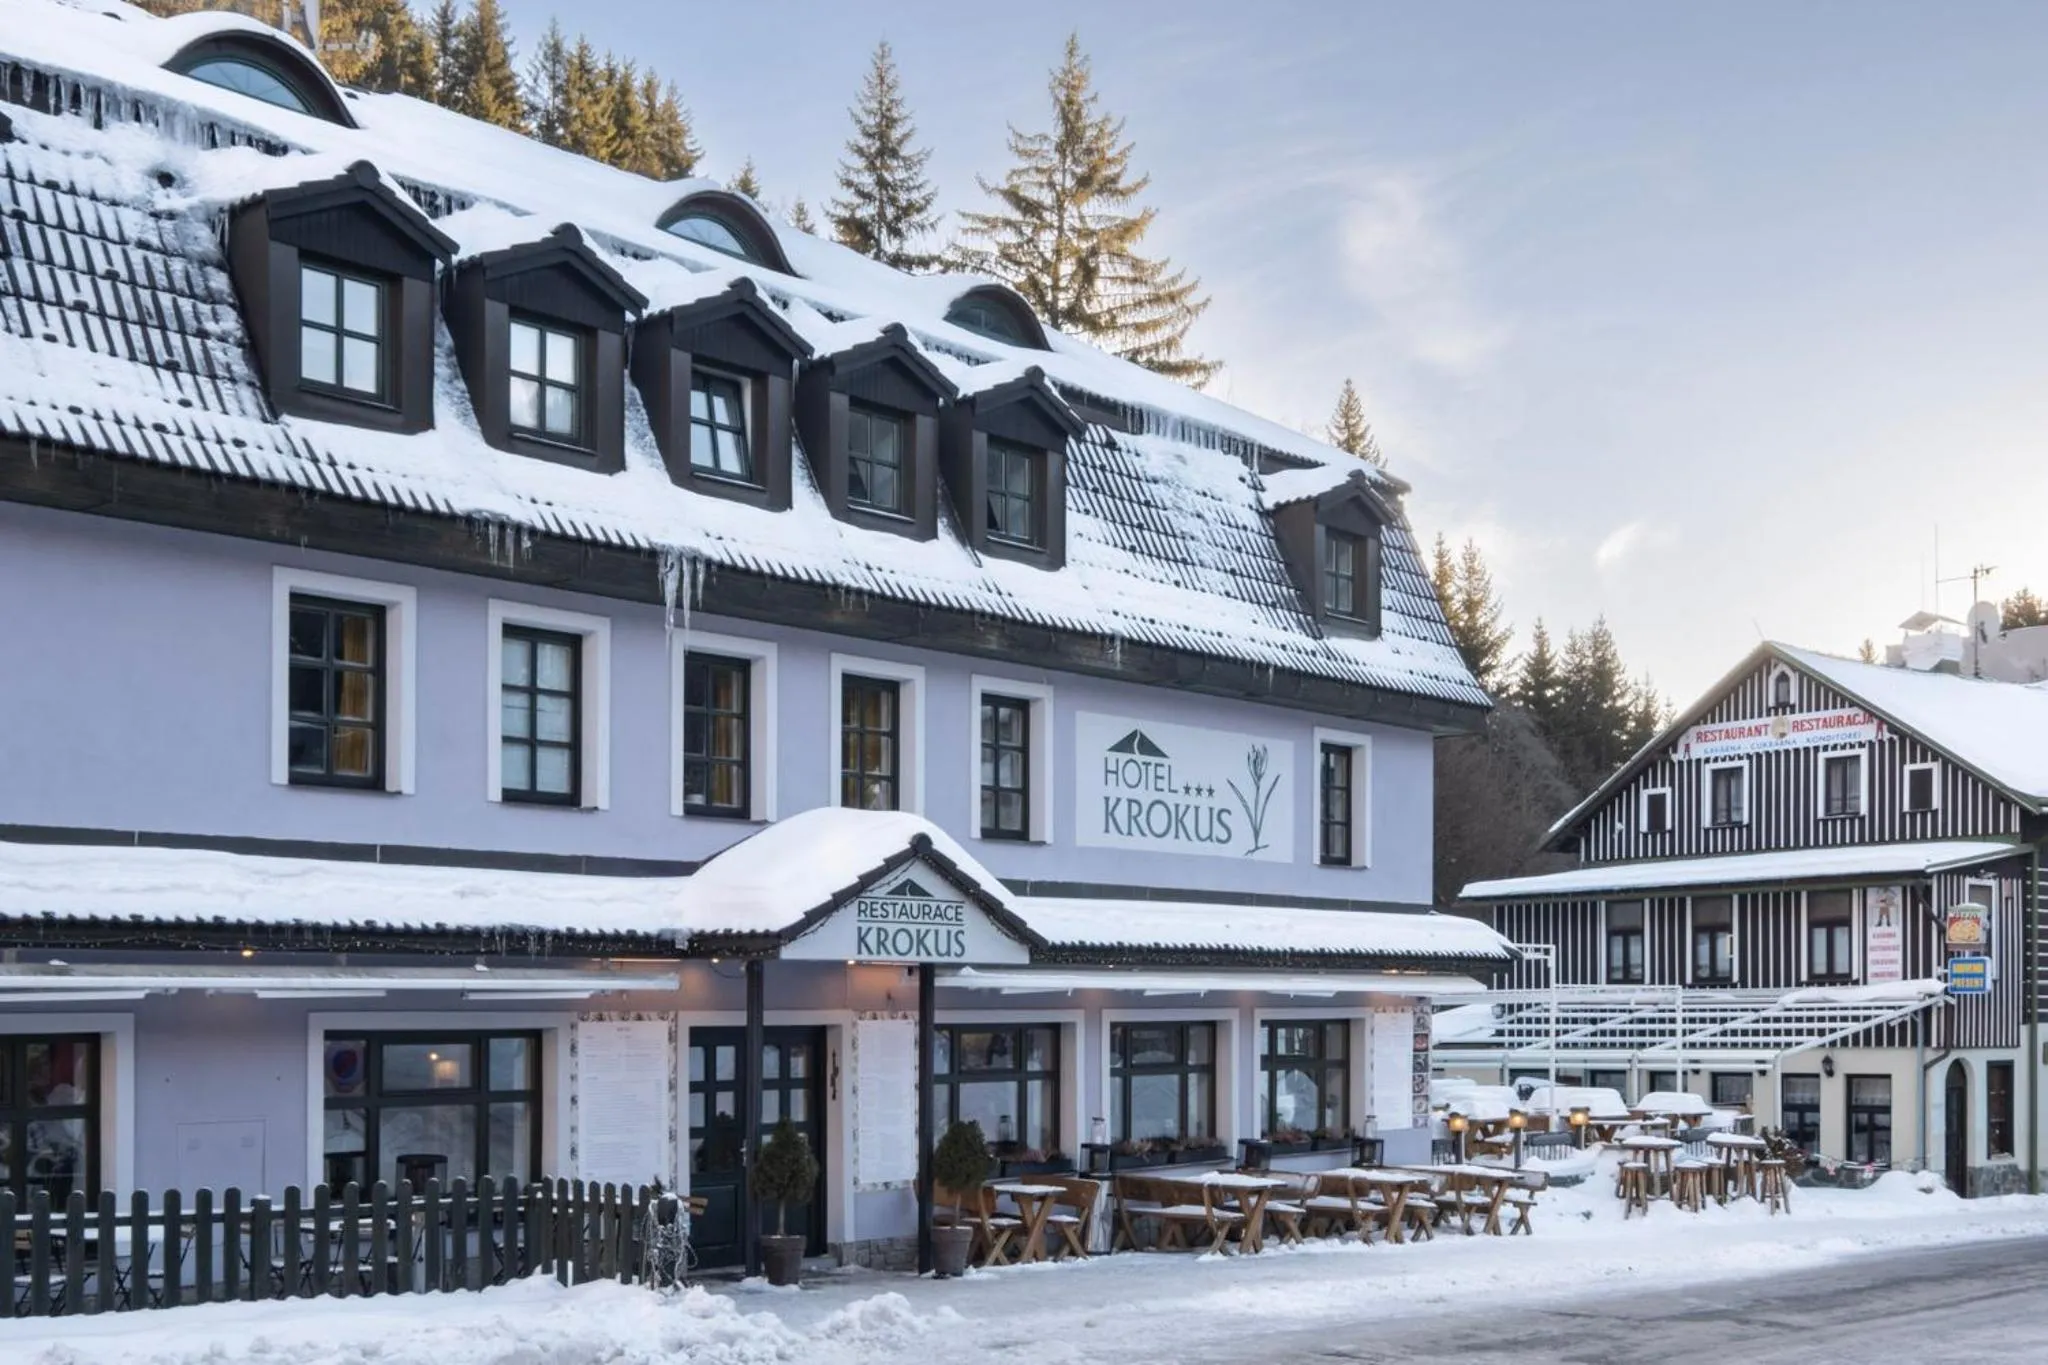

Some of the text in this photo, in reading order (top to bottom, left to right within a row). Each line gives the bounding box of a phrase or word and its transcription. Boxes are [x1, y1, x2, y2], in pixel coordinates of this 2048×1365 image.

[1696, 712, 1874, 743] RESTAURANT RESTAURACJA
[1104, 756, 1179, 793] HOTEL
[1103, 796, 1233, 845] KROKUS
[856, 901, 964, 922] RESTAURACE
[856, 926, 966, 958] KROKUS
